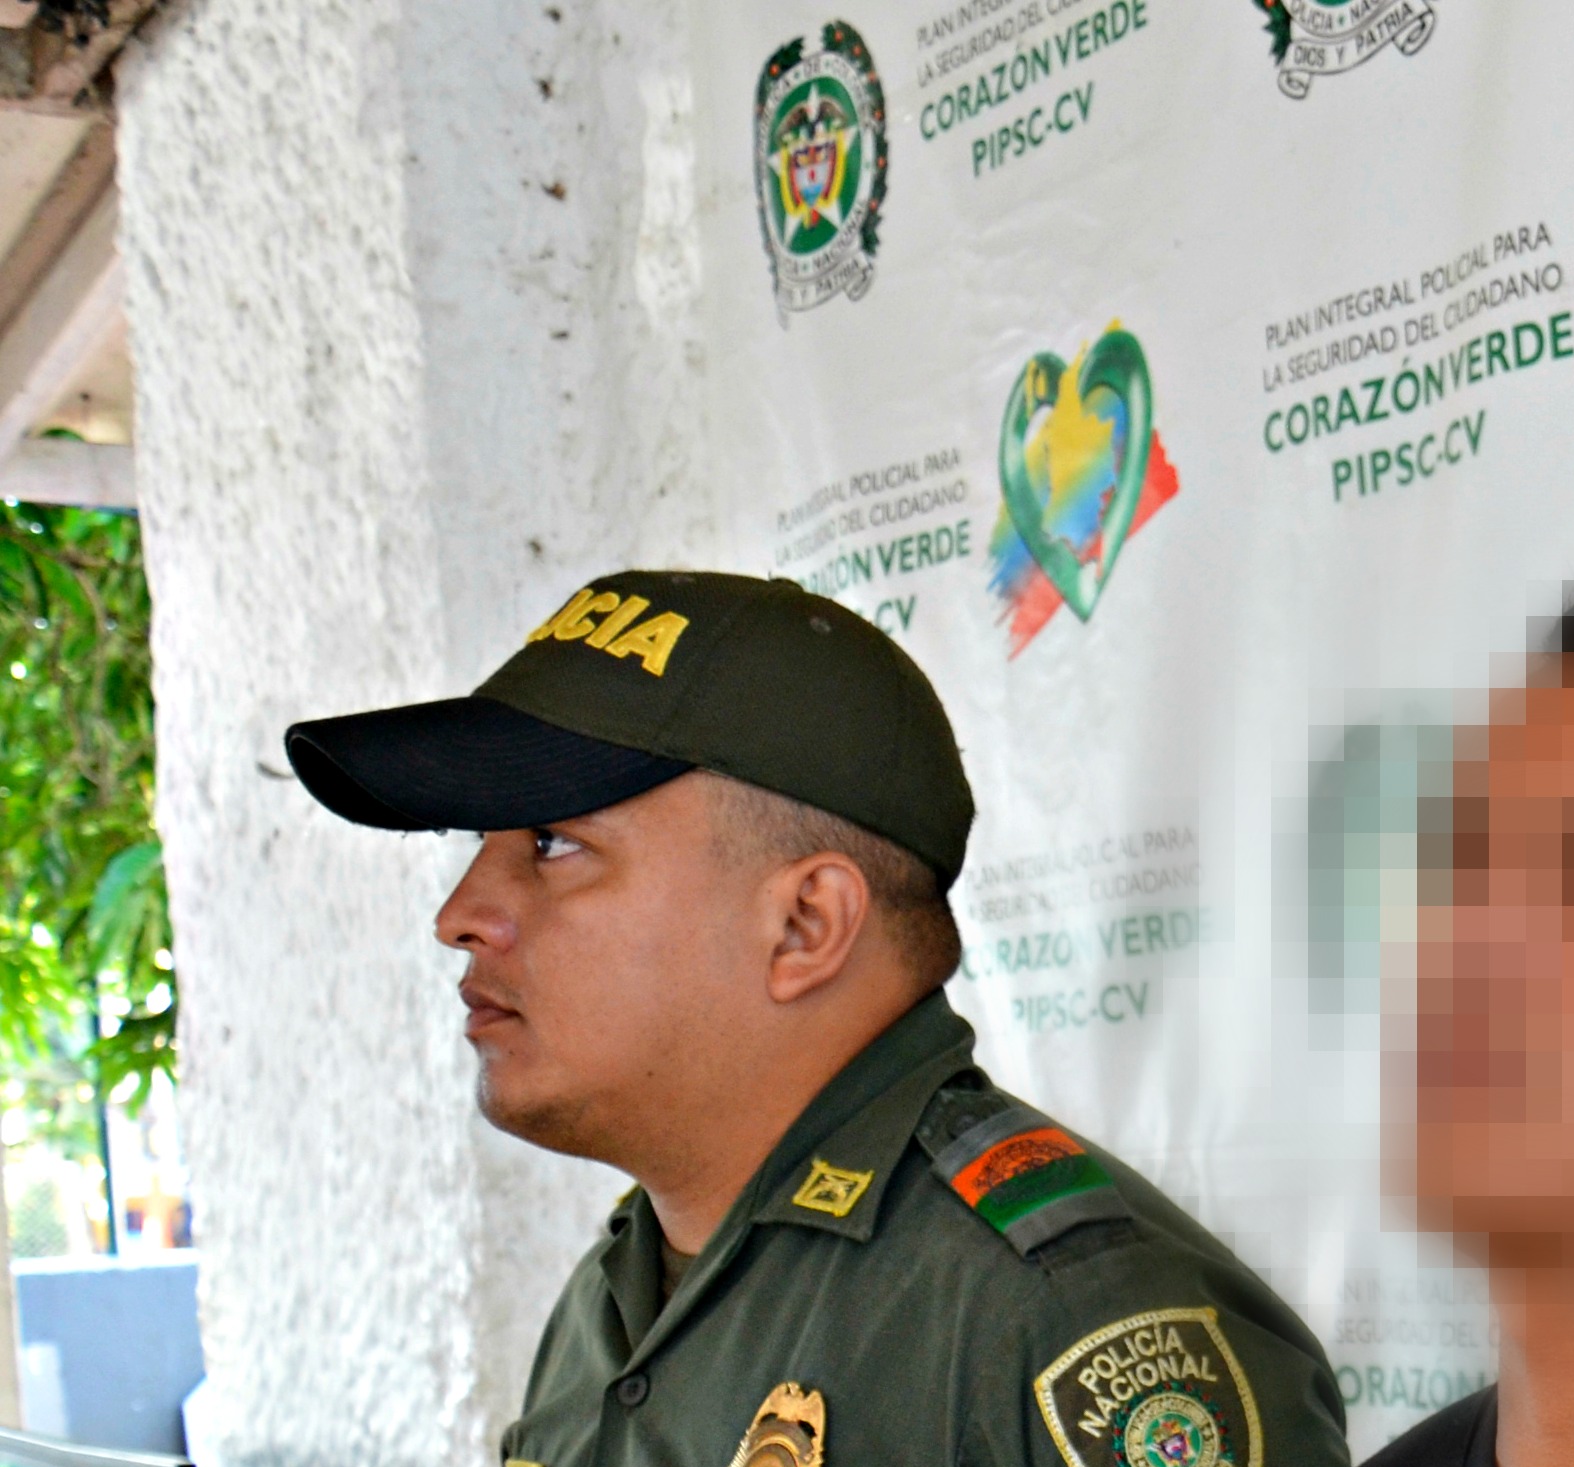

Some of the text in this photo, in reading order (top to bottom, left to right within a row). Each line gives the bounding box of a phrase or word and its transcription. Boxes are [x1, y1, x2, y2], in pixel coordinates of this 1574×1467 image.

[956, 0, 1013, 32] INTEG
[1290, 0, 1334, 31] OLICIA
[1335, 46, 1345, 65] Y
[1355, 1, 1414, 54] PATRIA
[919, 40, 1051, 141] CORAZÓN
[1054, 0, 1148, 68] VERDE
[972, 80, 1094, 178] PIPSC-CV
[1265, 312, 1311, 350] PLAN
[1313, 278, 1416, 333] INTEGRAL
[1493, 221, 1553, 262] PARA
[1262, 361, 1284, 393] LA
[1287, 326, 1399, 384] SEGURIDAD
[1404, 312, 1440, 347] DEL
[1263, 356, 1445, 454] CORAZÓN
[850, 461, 921, 497] POLICIAL
[924, 447, 961, 477] PARA
[1331, 408, 1486, 502] PIPSC-CV
[868, 478, 968, 527] CIUDADANO
[876, 518, 971, 577] VERDE
[527, 587, 691, 679] ICIA
[1143, 828, 1195, 853] PARA
[1078, 1355, 1218, 1439] NACIONAL
[1336, 1360, 1494, 1409] ORAZÓN
